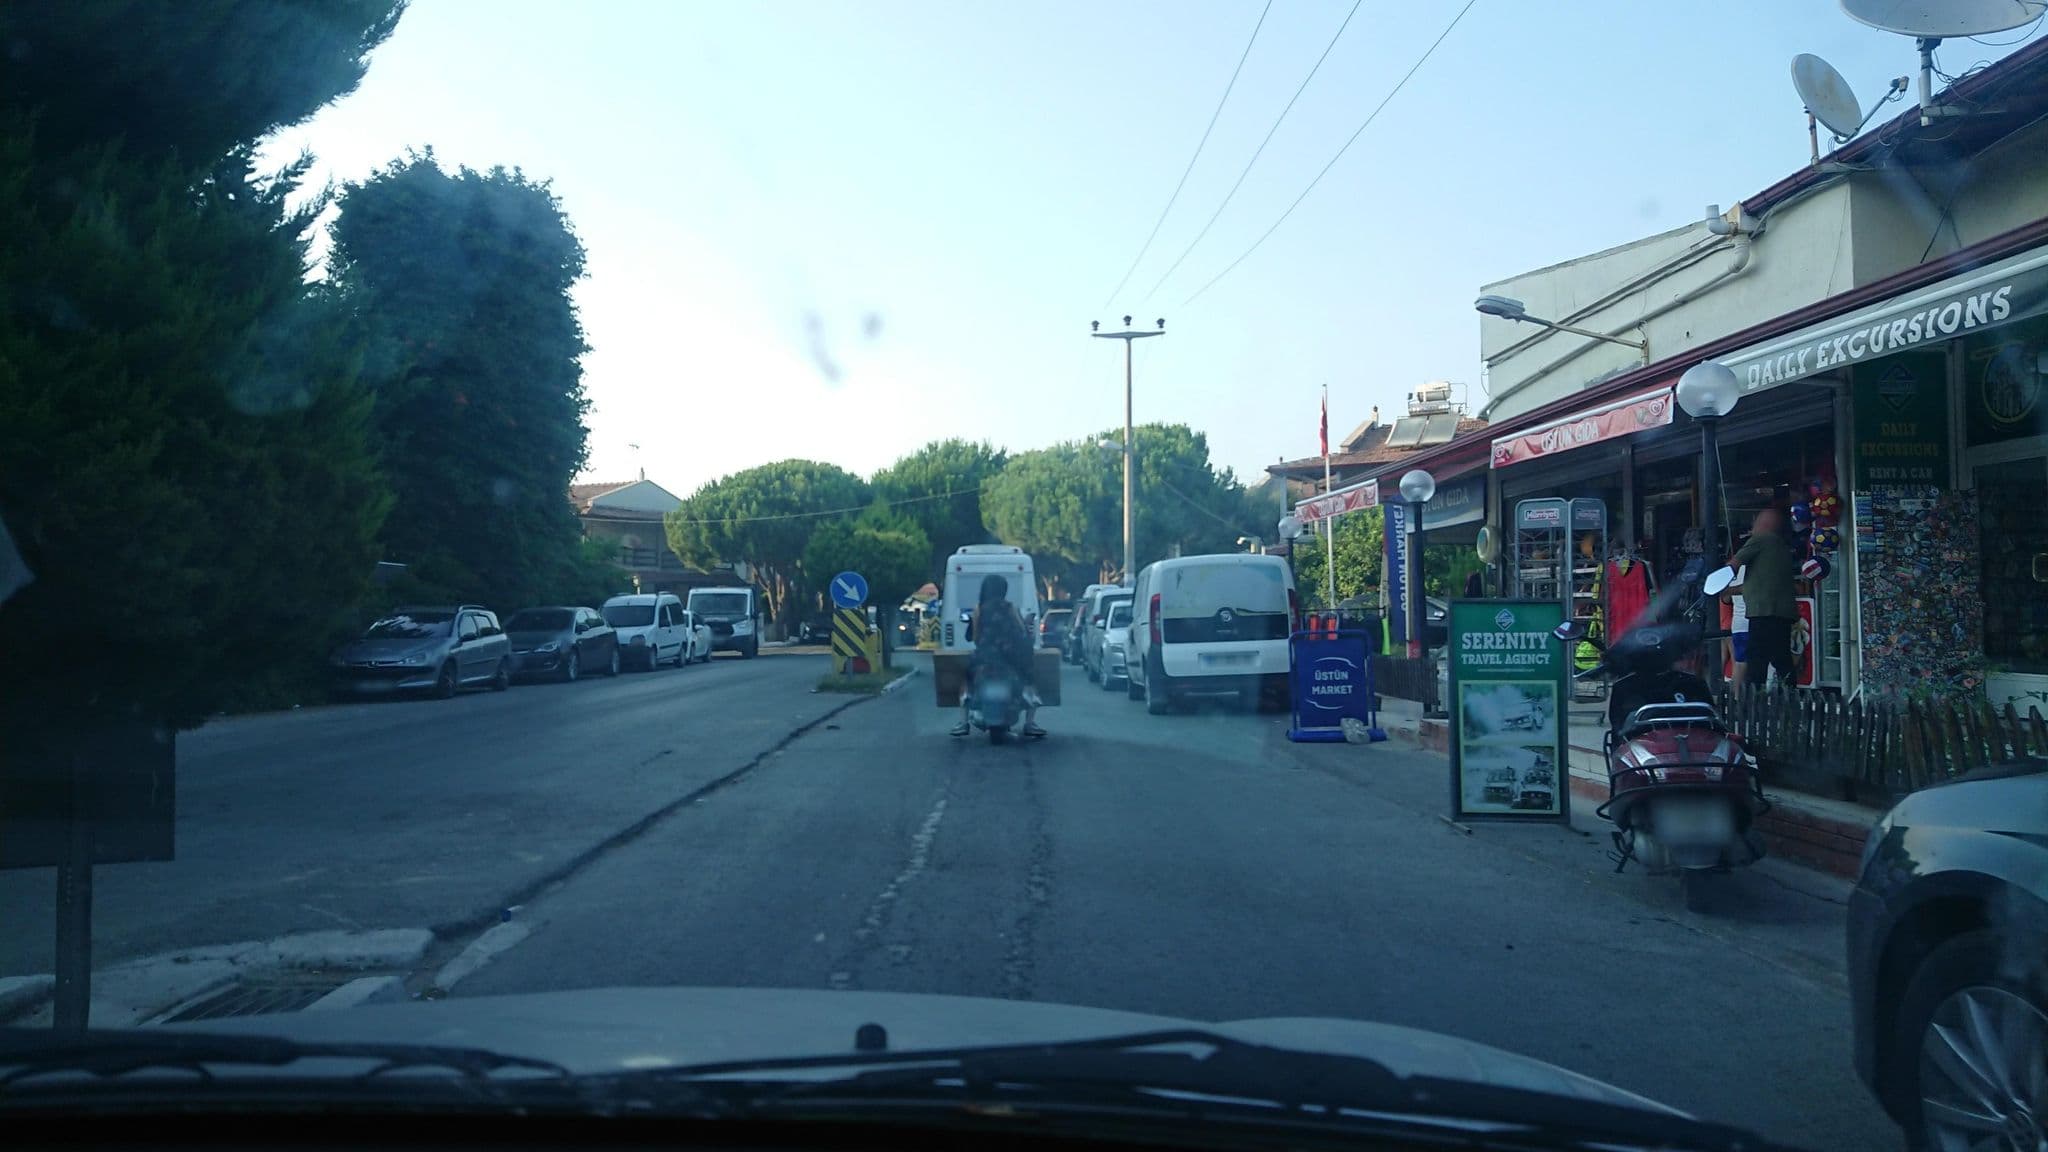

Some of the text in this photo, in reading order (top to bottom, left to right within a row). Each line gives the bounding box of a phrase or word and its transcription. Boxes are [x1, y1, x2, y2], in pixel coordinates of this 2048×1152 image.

[1747, 285, 2013, 389] DAILY EXCURSIONS
[1880, 422, 1918, 436] DAILY
[1869, 466, 1933, 479] RENT A CAR
[1461, 632, 1550, 650] SERENITY
[1461, 653, 1551, 665] TRAVEL AGENCY
[1314, 670, 1349, 680] ÜSTÜN
[1311, 685, 1353, 695] MARKET
